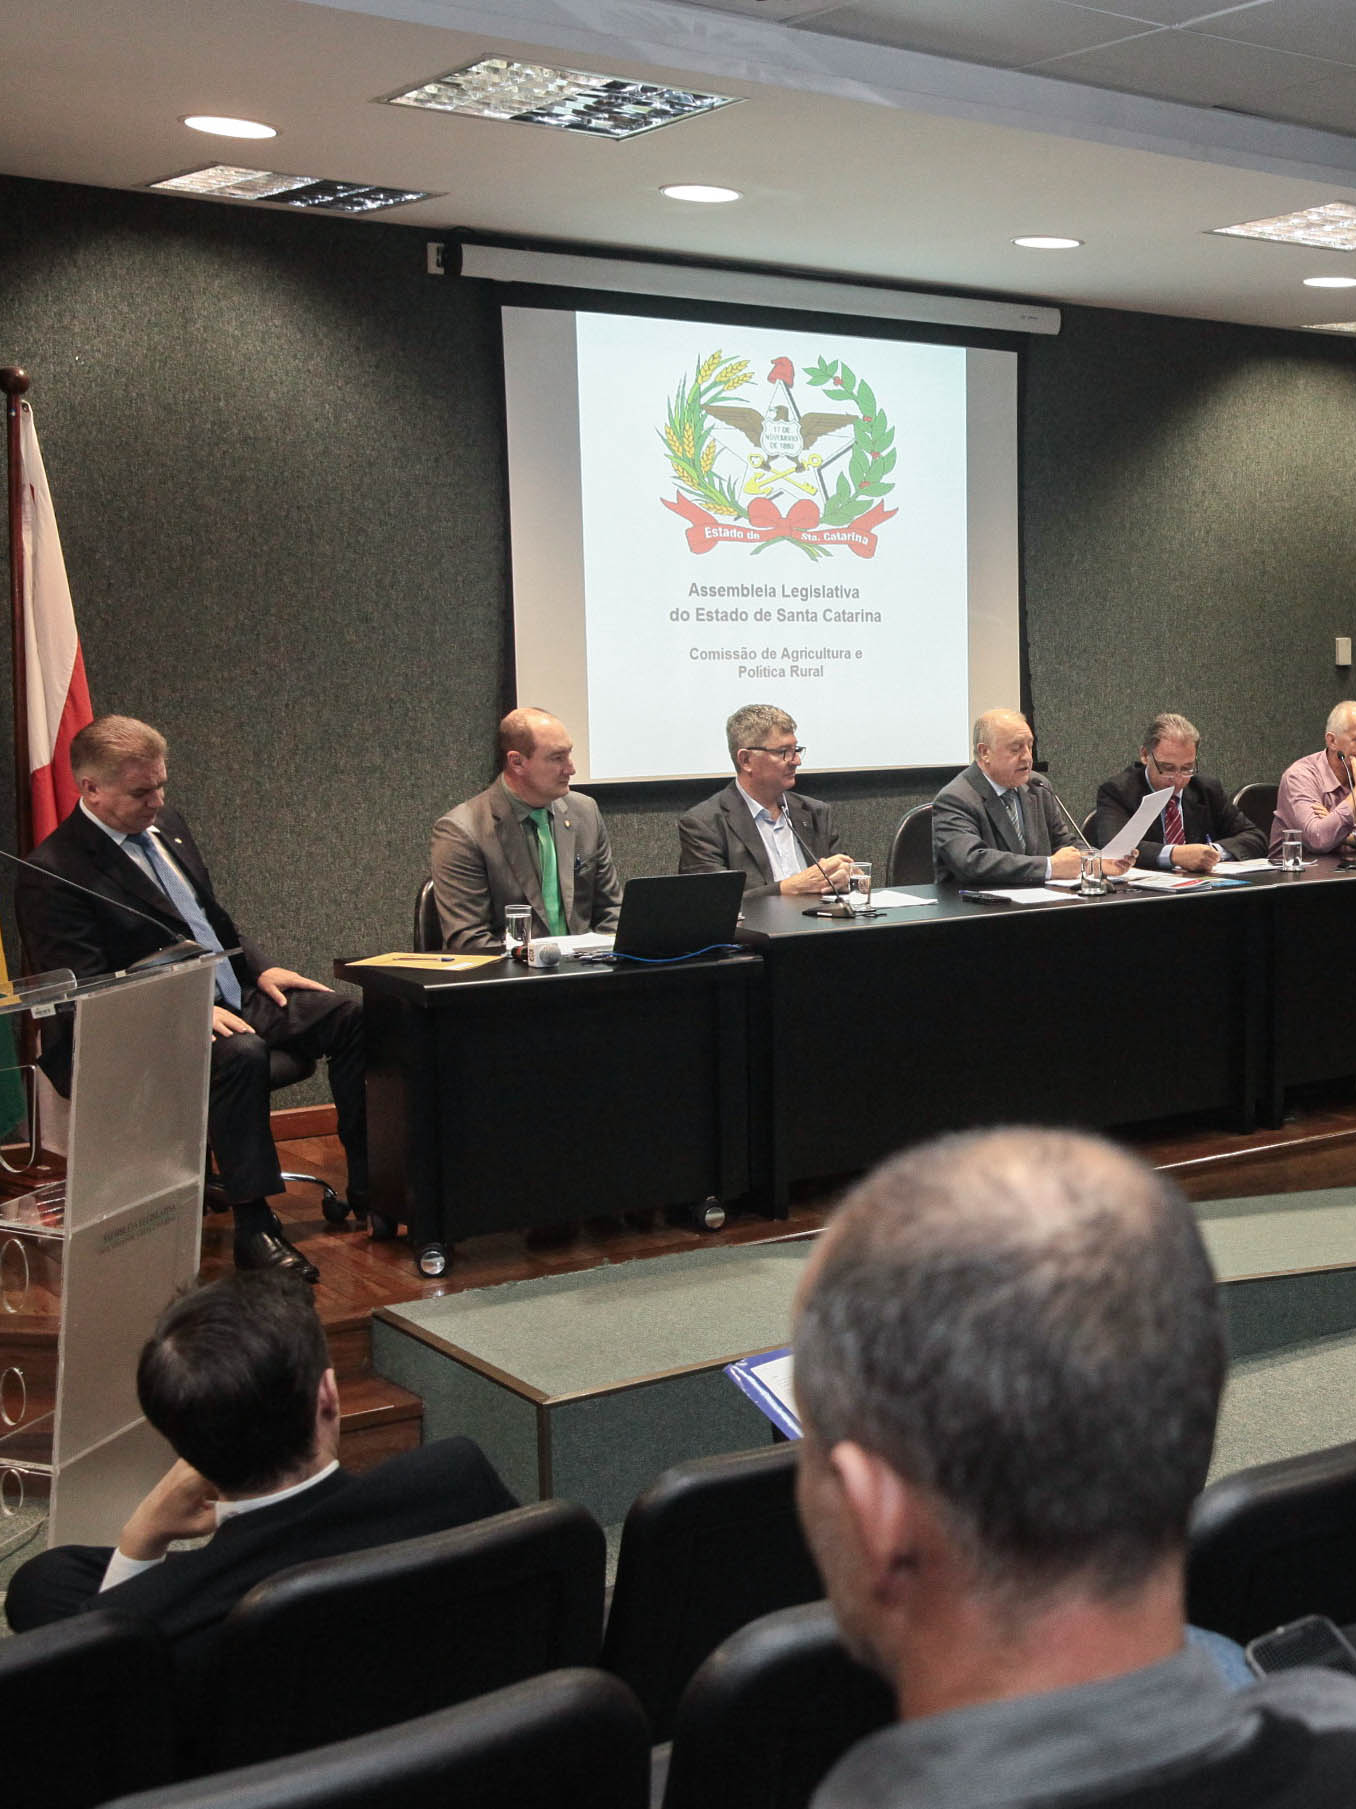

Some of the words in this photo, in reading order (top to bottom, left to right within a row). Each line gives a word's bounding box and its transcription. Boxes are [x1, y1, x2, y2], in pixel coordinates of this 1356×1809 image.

[704, 526, 744, 539] Estado
[823, 531, 869, 545] Catarina
[688, 582, 777, 599] Assembleia
[781, 583, 861, 602] Legislativa
[669, 608, 690, 622] do
[695, 607, 749, 622] Estado
[753, 608, 772, 622] de
[776, 608, 818, 623] Santa
[822, 608, 882, 623] Catarina
[689, 646, 757, 661] Comissão
[761, 647, 777, 660] de
[780, 647, 851, 662] Agricultura
[855, 649, 863, 659] e
[738, 664, 786, 679] Política
[790, 664, 824, 678] Rural
